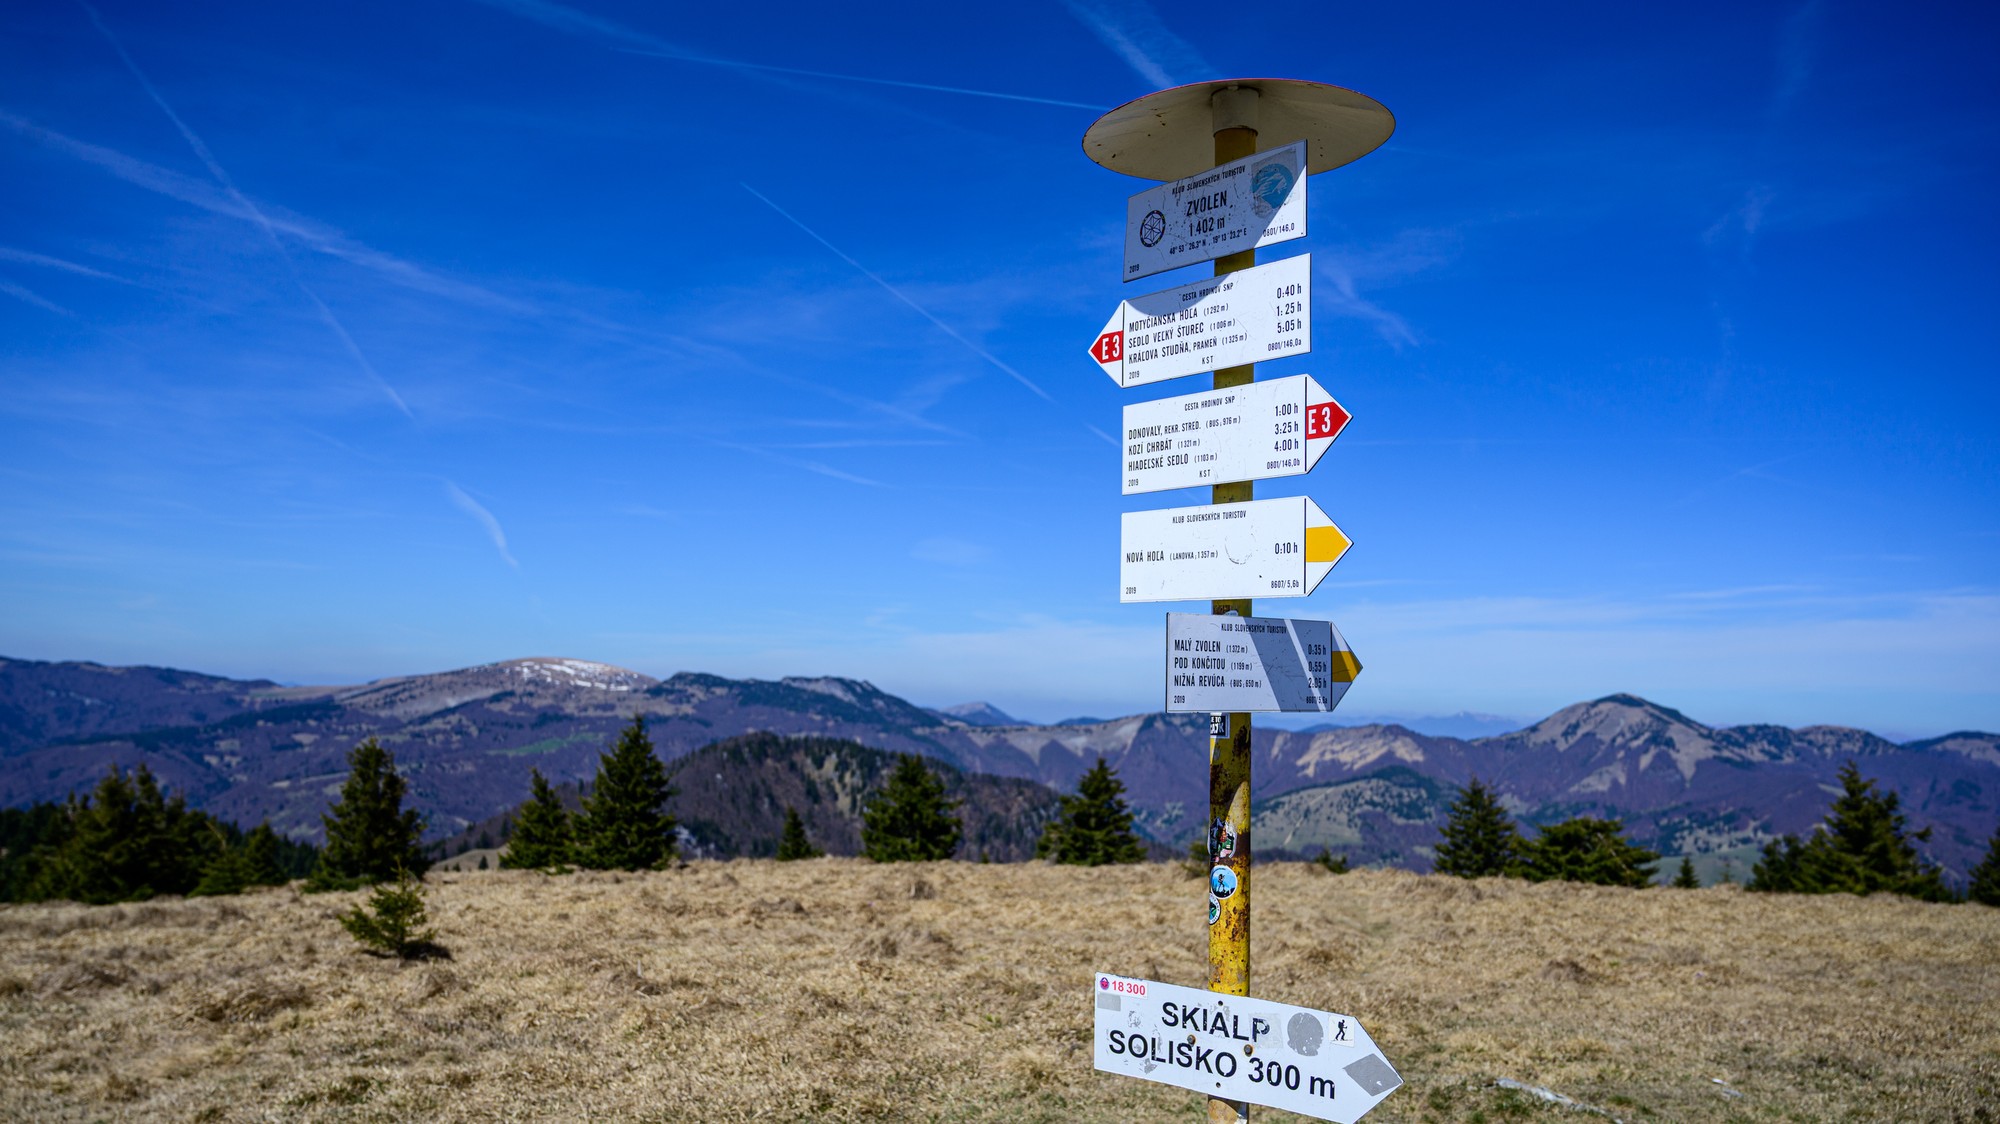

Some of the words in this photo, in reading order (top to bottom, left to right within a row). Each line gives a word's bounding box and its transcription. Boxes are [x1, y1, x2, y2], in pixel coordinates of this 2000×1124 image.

[1172, 185, 1185, 195] KLUB
[1187, 173, 1220, 191] SLOVENSKÝCH
[1222, 165, 1245, 180] TURISTOV
[1186, 190, 1227, 216] ZVOLEN
[1217, 217, 1225, 229] m
[1129, 264, 1140, 273] 2019
[1182, 291, 1197, 302] CESTA
[1199, 286, 1220, 298] HRDINOV
[1223, 282, 1234, 292] SNP
[1129, 312, 1176, 333] MOTYČIANSKA
[1180, 307, 1198, 321] HOĽA
[1276, 284, 1295, 299] 0:40
[1297, 283, 1302, 294] h
[1128, 334, 1150, 348] SEDLO
[1153, 327, 1174, 343] VEĽKÝ
[1177, 322, 1204, 338] ŠTUREC
[1276, 302, 1295, 316] 1:25
[1297, 301, 1302, 312] h
[1128, 347, 1158, 364] KRÁĽOVA
[1162, 340, 1192, 358] STUDŇA,
[1193, 336, 1217, 351] PRAMEŇ
[1277, 319, 1295, 334] 5:05
[1297, 318, 1302, 330] h
[1129, 370, 1140, 380] 2019
[1184, 402, 1199, 411] CESTA
[1201, 398, 1223, 408] HRDINOV
[1225, 396, 1235, 404] SNP
[1128, 425, 1163, 440] DONOVALY,
[1164, 424, 1180, 434] REKR.
[1182, 420, 1201, 432] STRED.
[1275, 404, 1292, 417] 1:00
[1294, 403, 1299, 414] h
[1128, 442, 1143, 456] KOZÍ
[1146, 438, 1172, 453] CHRBÁT
[1274, 422, 1292, 435] 3:25
[1294, 421, 1299, 432] h
[1128, 455, 1163, 472] HIADEĽSKÉ
[1167, 453, 1189, 466] SEDLO
[1274, 440, 1292, 452] 4:00
[1294, 438, 1299, 450] h
[1187, 512, 1220, 523] SLOVENSKÝCH
[1223, 510, 1246, 520] TURISTOV
[1126, 550, 1143, 562] NOVÁ
[1147, 550, 1164, 562] HOĽA
[1275, 542, 1291, 554] 0:10
[1294, 542, 1298, 553] h
[1235, 624, 1265, 632] SLOVENSKÝCH
[1267, 625, 1287, 634] TURISTOV
[1175, 638, 1192, 651] MALÝ
[1196, 640, 1220, 652] ZVOLEN
[1308, 644, 1321, 655] 0:35
[1323, 645, 1326, 655] h
[1175, 657, 1188, 669] POD
[1192, 656, 1225, 669] KONČITOU
[1308, 661, 1321, 672] 0:55
[1323, 662, 1326, 672] h
[1174, 673, 1195, 686] NIŽNÁ
[1199, 674, 1224, 687] REVÚCA
[1323, 678, 1326, 688] h
[1174, 695, 1185, 703] 2019
[1112, 981, 1124, 992] 18
[1126, 983, 1145, 995] 300
[1161, 1001, 1271, 1043] SKIALP
[1108, 1029, 1238, 1077] SOLISKO
[1247, 1057, 1301, 1091] 300
[1310, 1075, 1336, 1100] m
